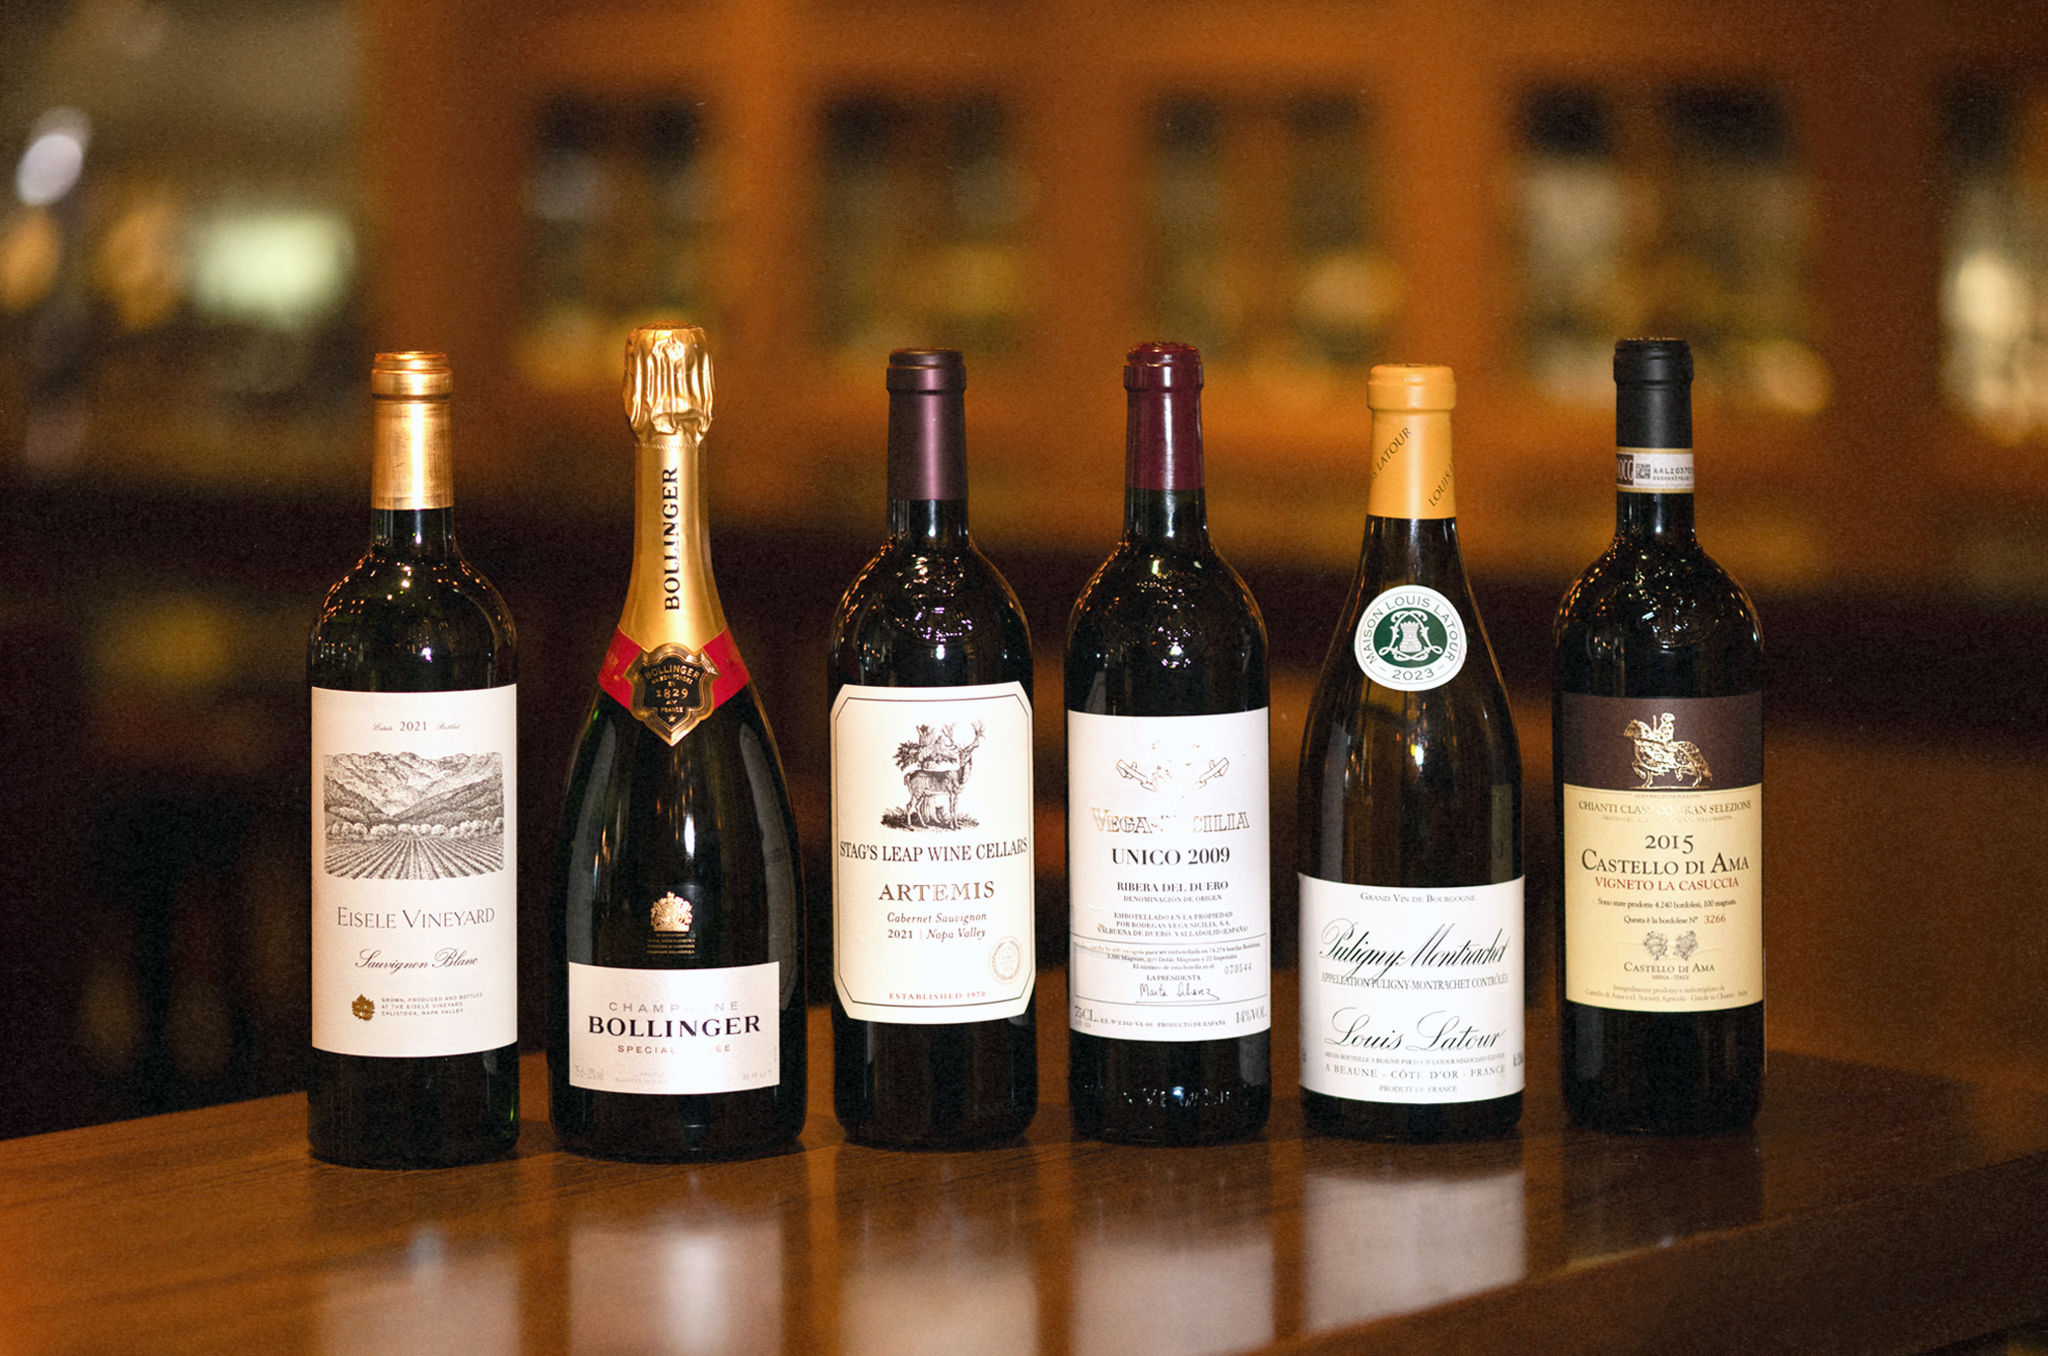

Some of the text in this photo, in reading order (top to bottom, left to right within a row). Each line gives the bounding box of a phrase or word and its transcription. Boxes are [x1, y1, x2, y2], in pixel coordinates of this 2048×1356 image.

[1376, 427, 1411, 471] LATOUR
[1427, 470, 1451, 507] LOUIS
[661, 466, 680, 612] BOLLINGER
[1362, 595, 1459, 665] MAISON LOUIS LATOUR
[644, 664, 701, 680] BOLLINGER
[1391, 667, 1434, 681] 2023
[655, 688, 689, 699] 1829
[399, 720, 427, 731] 2021
[1578, 800, 1618, 813] CHIANTI
[1709, 800, 1751, 814] SELEZIONE
[840, 837, 1028, 862] STAG'S LEAP WINE CELLARS
[1645, 834, 1695, 854] 2015
[1111, 846, 1231, 866] UNICO 2009
[878, 880, 995, 902] ARTEMIS
[1117, 880, 1229, 892] RIBERA DEL DUERO
[1594, 876, 1739, 891] VIGNETO LA CASUCCIA
[337, 906, 496, 929] EISELE VINEYARD
[887, 911, 987, 925] Cabernet Sauvignon
[1114, 911, 1169, 921] EMBOTELLADO
[1194, 911, 1233, 920] PROPIEDAD
[1703, 914, 1727, 924] 3266
[1116, 920, 1130, 928] POR
[887, 927, 986, 942] 2021 Napa Valley
[355, 947, 479, 975] Sauvignon Blanc
[889, 991, 986, 1001] ESTABLISHED 1970
[588, 1015, 762, 1038] BOLLINGER
[1324, 1006, 1506, 1052] Louis Latour
[617, 1045, 677, 1054] SPECIAL
[742, 1069, 774, 1081] BRUT
[1324, 1063, 1331, 1072] A
[1333, 1064, 1378, 1077] BEAUNE
[1470, 1064, 1506, 1078] FRANCE
